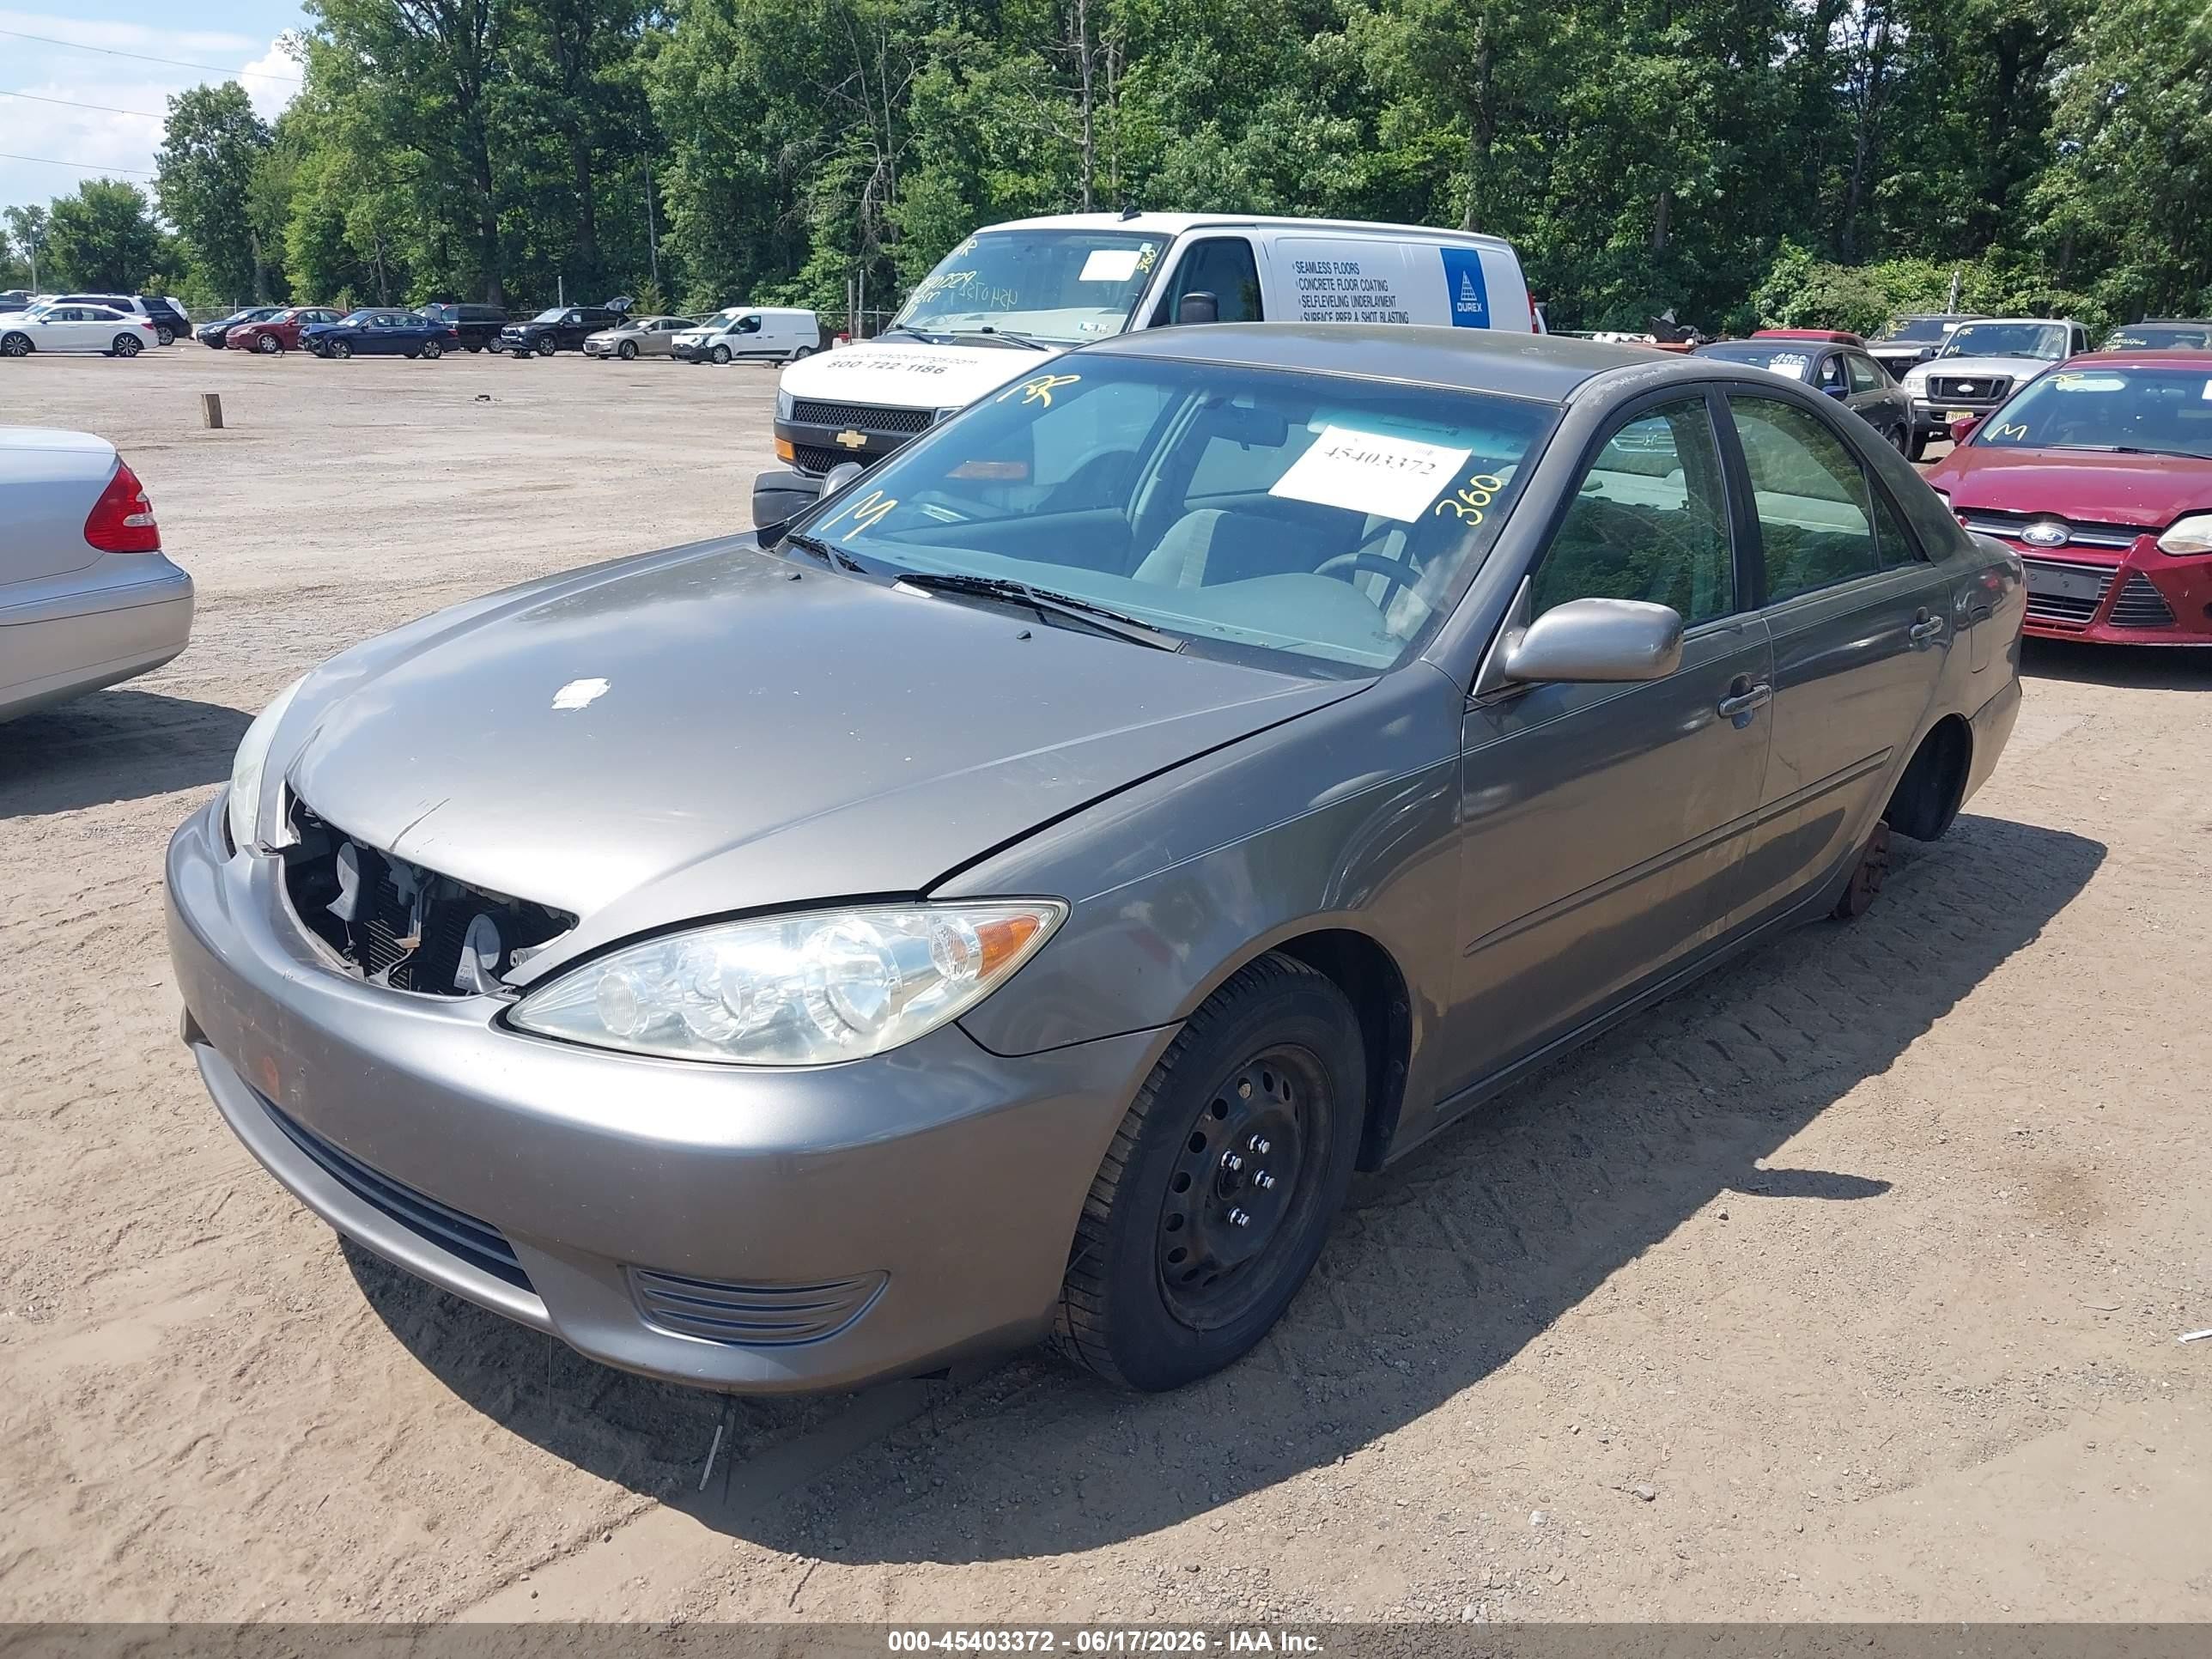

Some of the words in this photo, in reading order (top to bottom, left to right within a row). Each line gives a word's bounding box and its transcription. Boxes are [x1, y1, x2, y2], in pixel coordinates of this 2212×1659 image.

[1136, 249, 1157, 274] 360
[1295, 261, 1332, 275] SEAMLESS
[1334, 262, 1360, 276] FLOORS
[1298, 277, 1336, 291] CONCRETE
[1337, 278, 1359, 291] FLOOR
[1360, 279, 1389, 292] COATING
[1301, 295, 1349, 308] SELFLEVELING
[1351, 295, 1396, 308] UNDERLAYMENT
[1456, 302, 1483, 313] DUREX
[1304, 312, 1334, 322] SURFACE
[1335, 312, 1352, 322] PREP
[1361, 312, 1378, 323] SHOT
[1379, 312, 1409, 324] BLASTING
[826, 361, 950, 374] 800-722-1186
[1987, 422, 2027, 442] M
[1325, 445, 1437, 476] 45403372
[1435, 474, 1503, 526] 360
[821, 489, 898, 543] M
